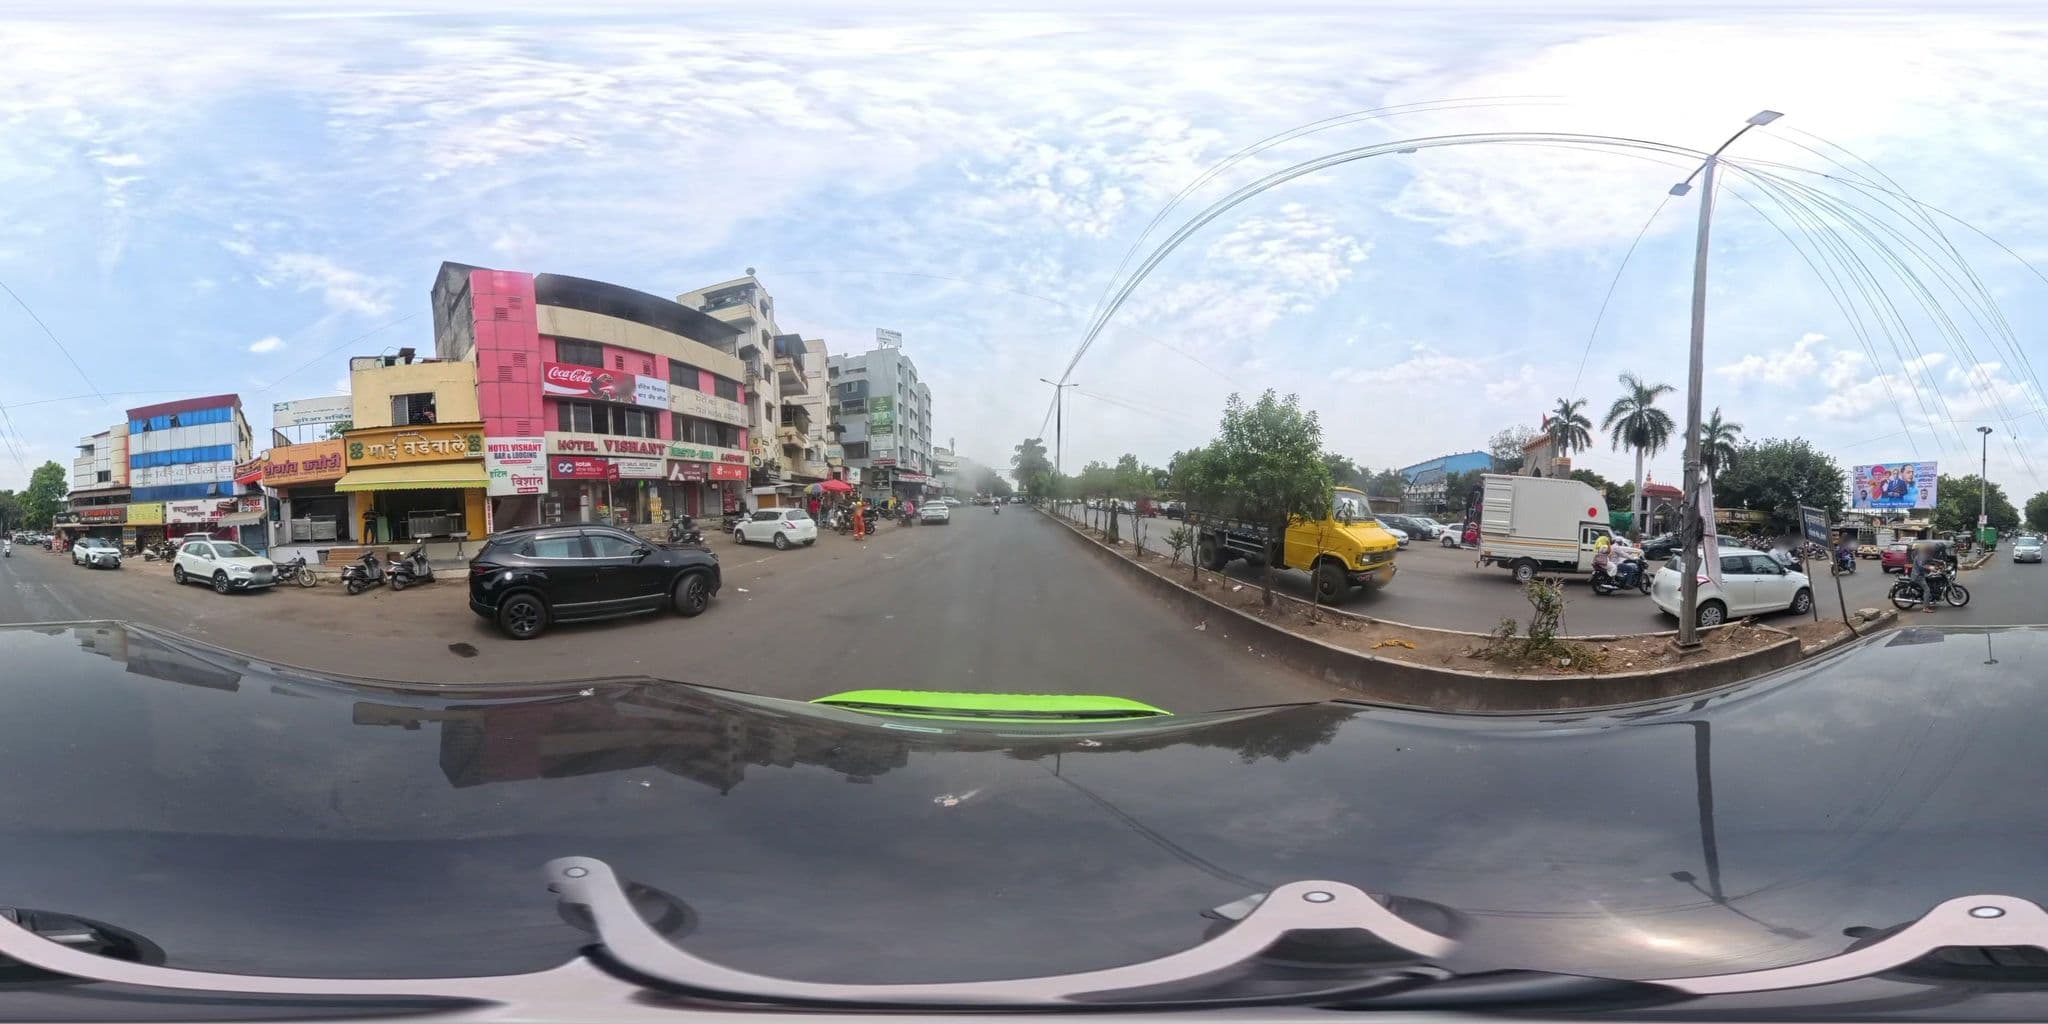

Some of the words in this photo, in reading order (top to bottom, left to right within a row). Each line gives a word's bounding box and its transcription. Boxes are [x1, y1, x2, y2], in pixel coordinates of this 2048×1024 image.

[548, 366, 593, 383] Coca-Cola
[367, 437, 398, 460] माई
[404, 433, 467, 456] वडेवाले
[488, 444, 510, 452] HOTEL
[511, 443, 542, 452] VISHANT
[558, 440, 598, 452] HOTEL
[603, 440, 666, 455] VISHANT
[511, 473, 544, 487] विशांत
